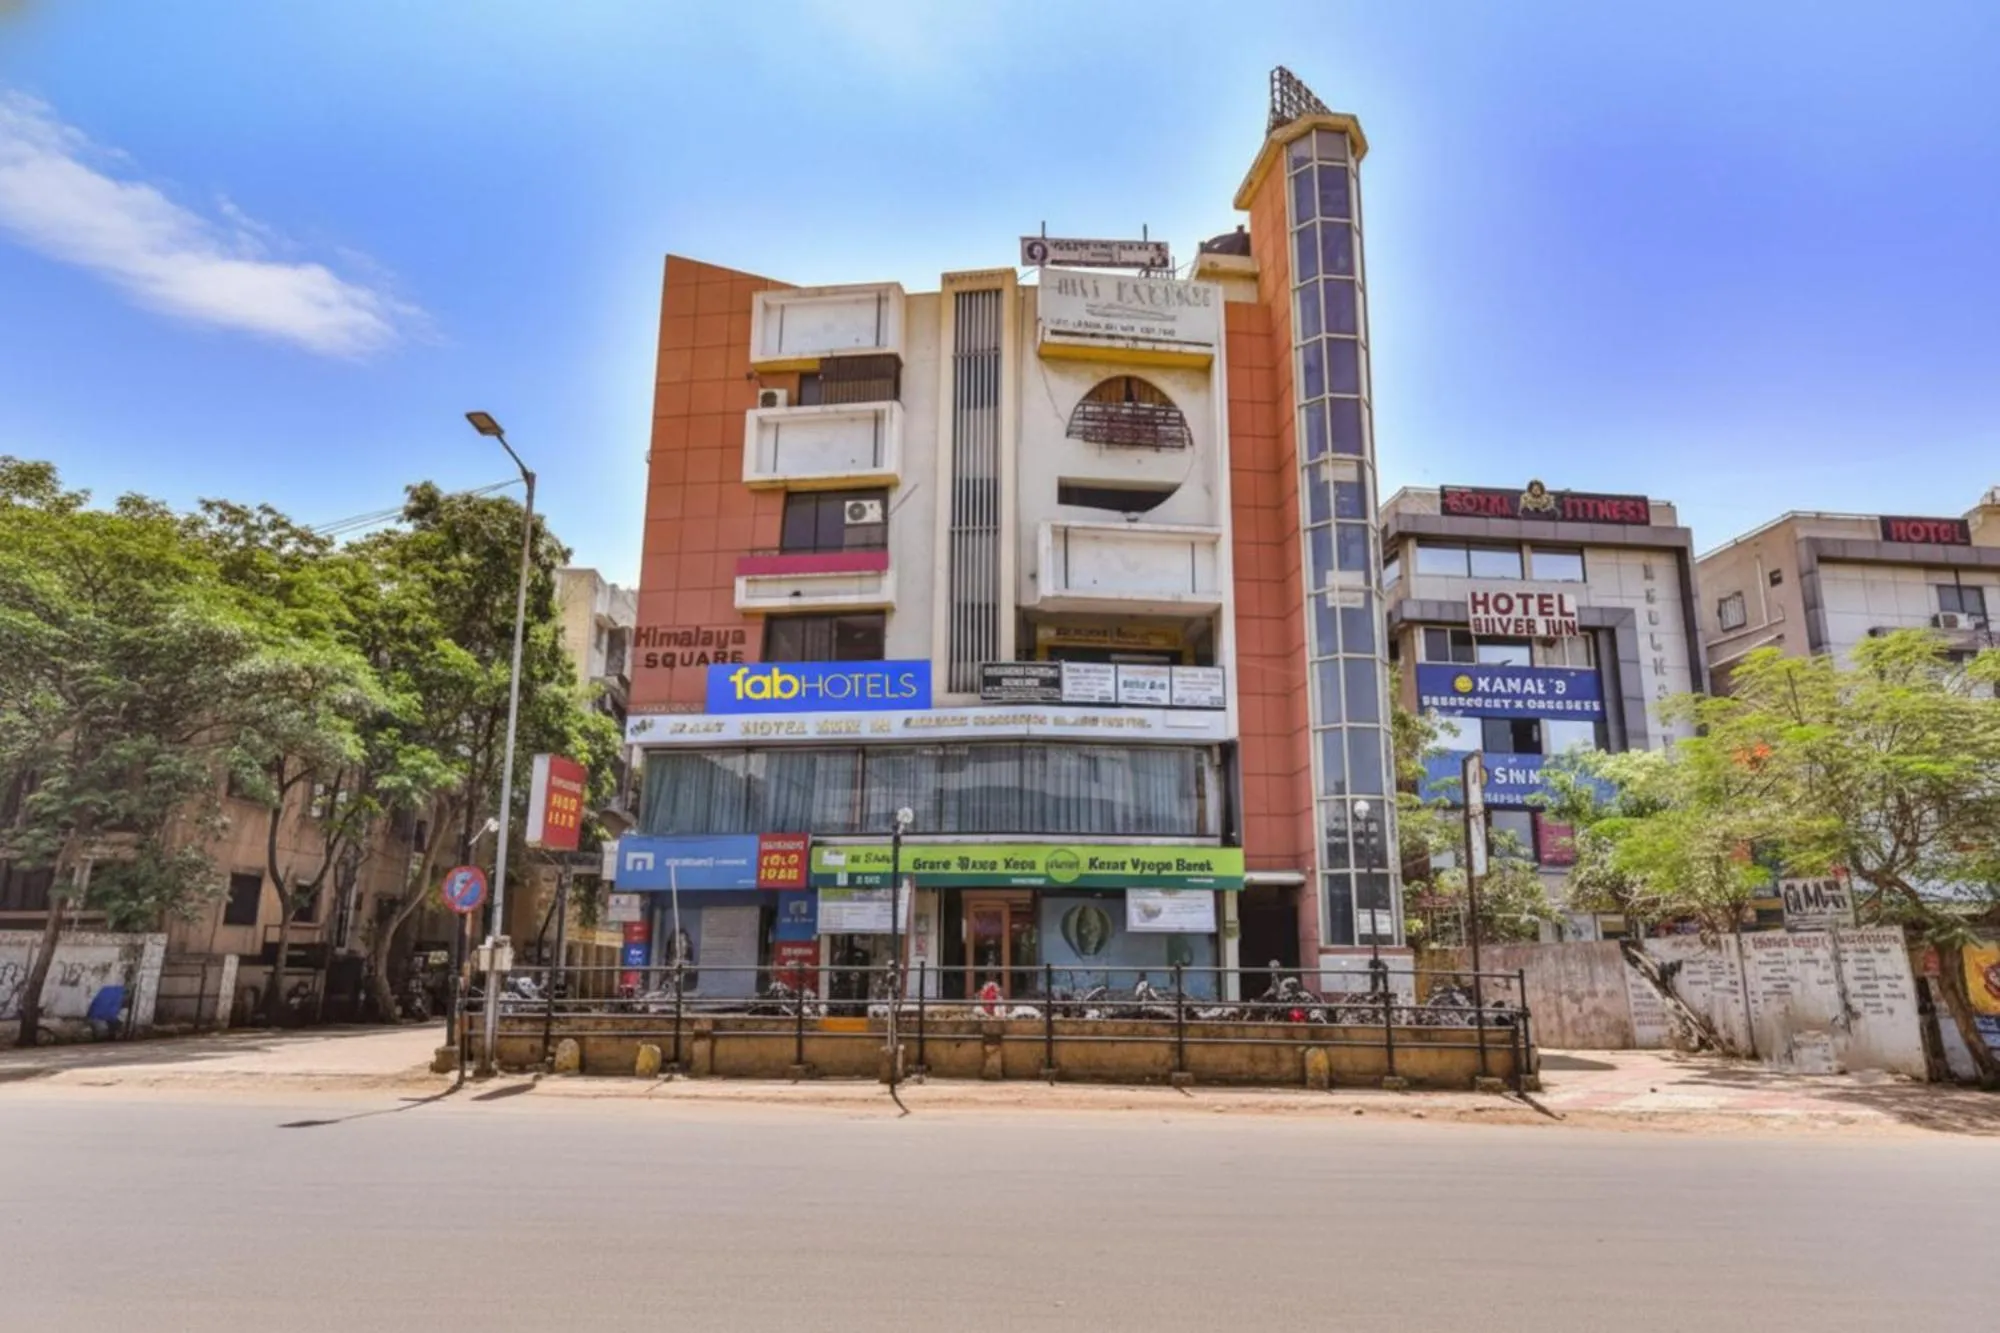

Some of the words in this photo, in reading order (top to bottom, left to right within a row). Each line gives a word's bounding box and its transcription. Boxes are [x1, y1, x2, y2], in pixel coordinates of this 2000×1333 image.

[1471, 592, 1574, 617] HOTEL
[634, 625, 746, 649] Himalaya
[645, 650, 745, 669] SQUARE
